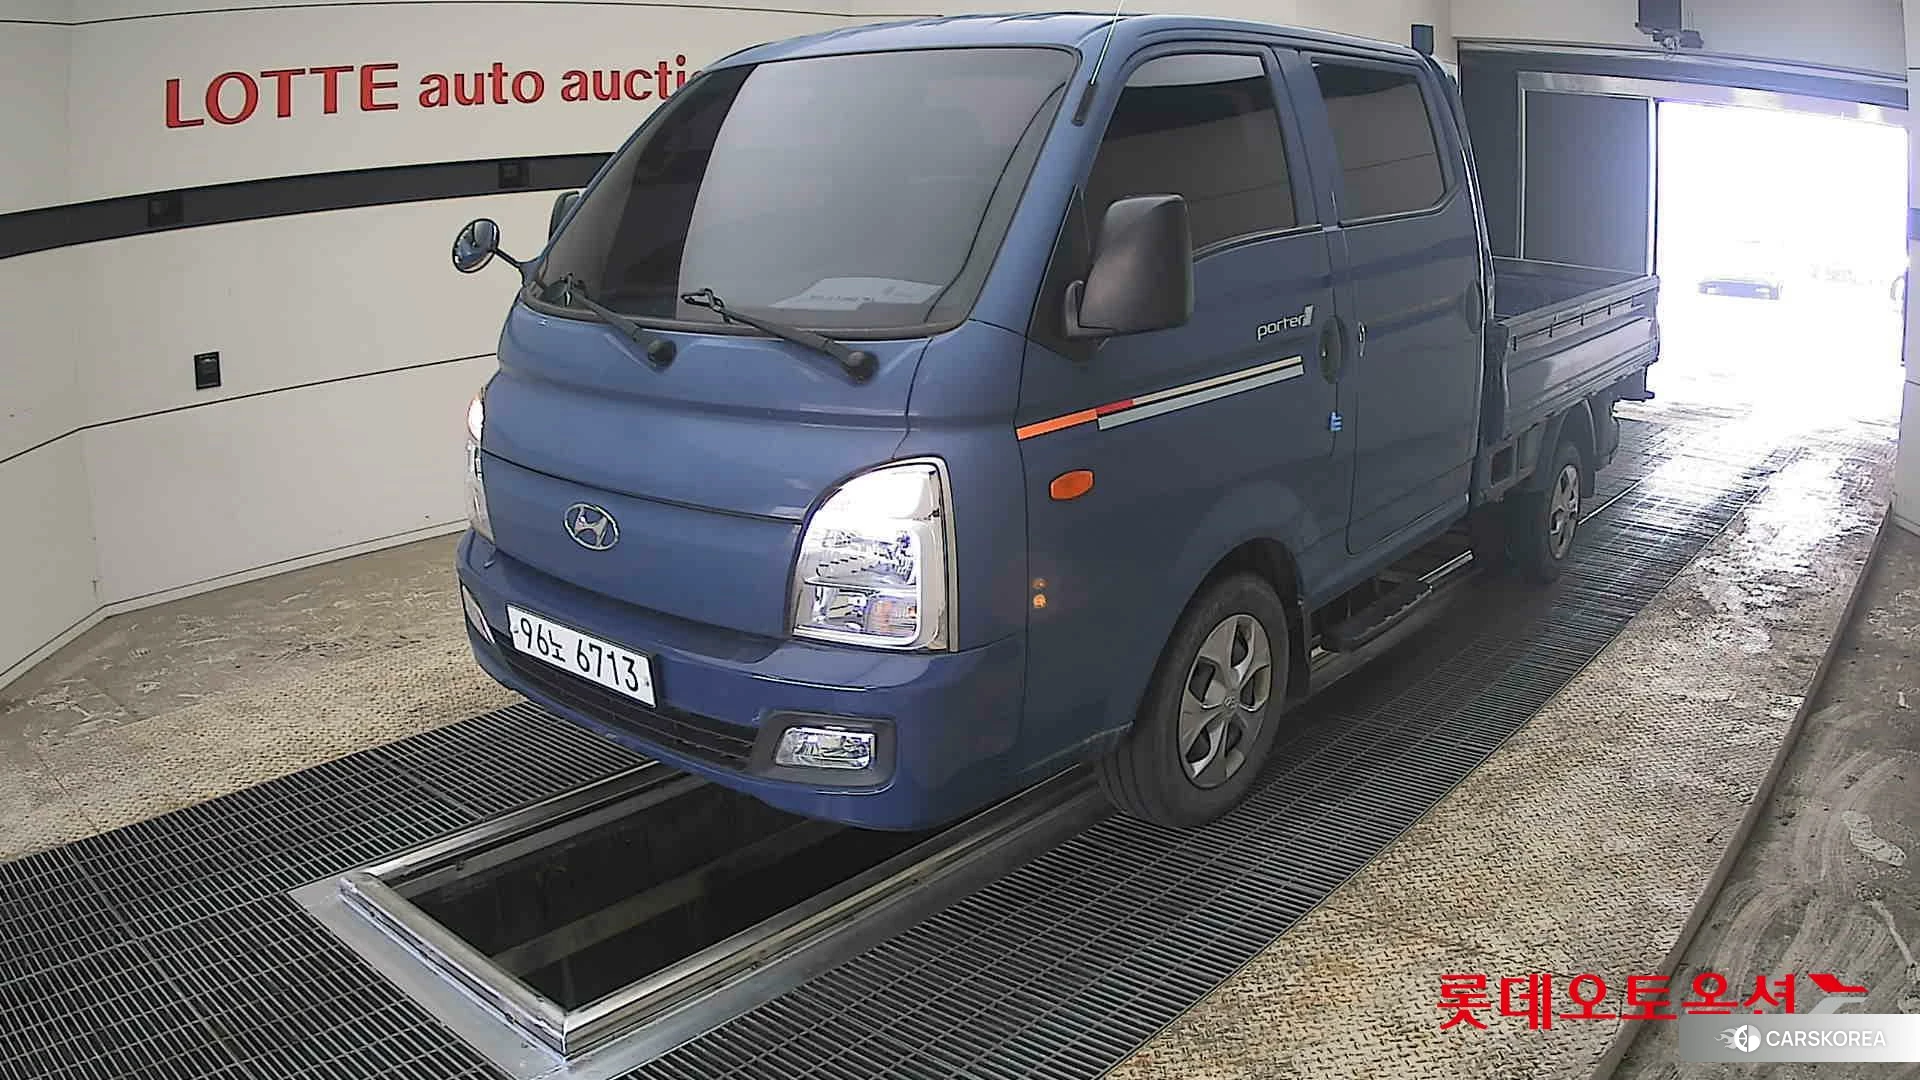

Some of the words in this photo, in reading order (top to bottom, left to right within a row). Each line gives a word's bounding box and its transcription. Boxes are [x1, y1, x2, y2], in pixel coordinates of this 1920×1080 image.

[165, 62, 399, 129] LOTTE
[418, 62, 545, 108] auto
[560, 53, 705, 103] aucti
[519, 617, 566, 663] 96노
[576, 639, 639, 692] 6713
